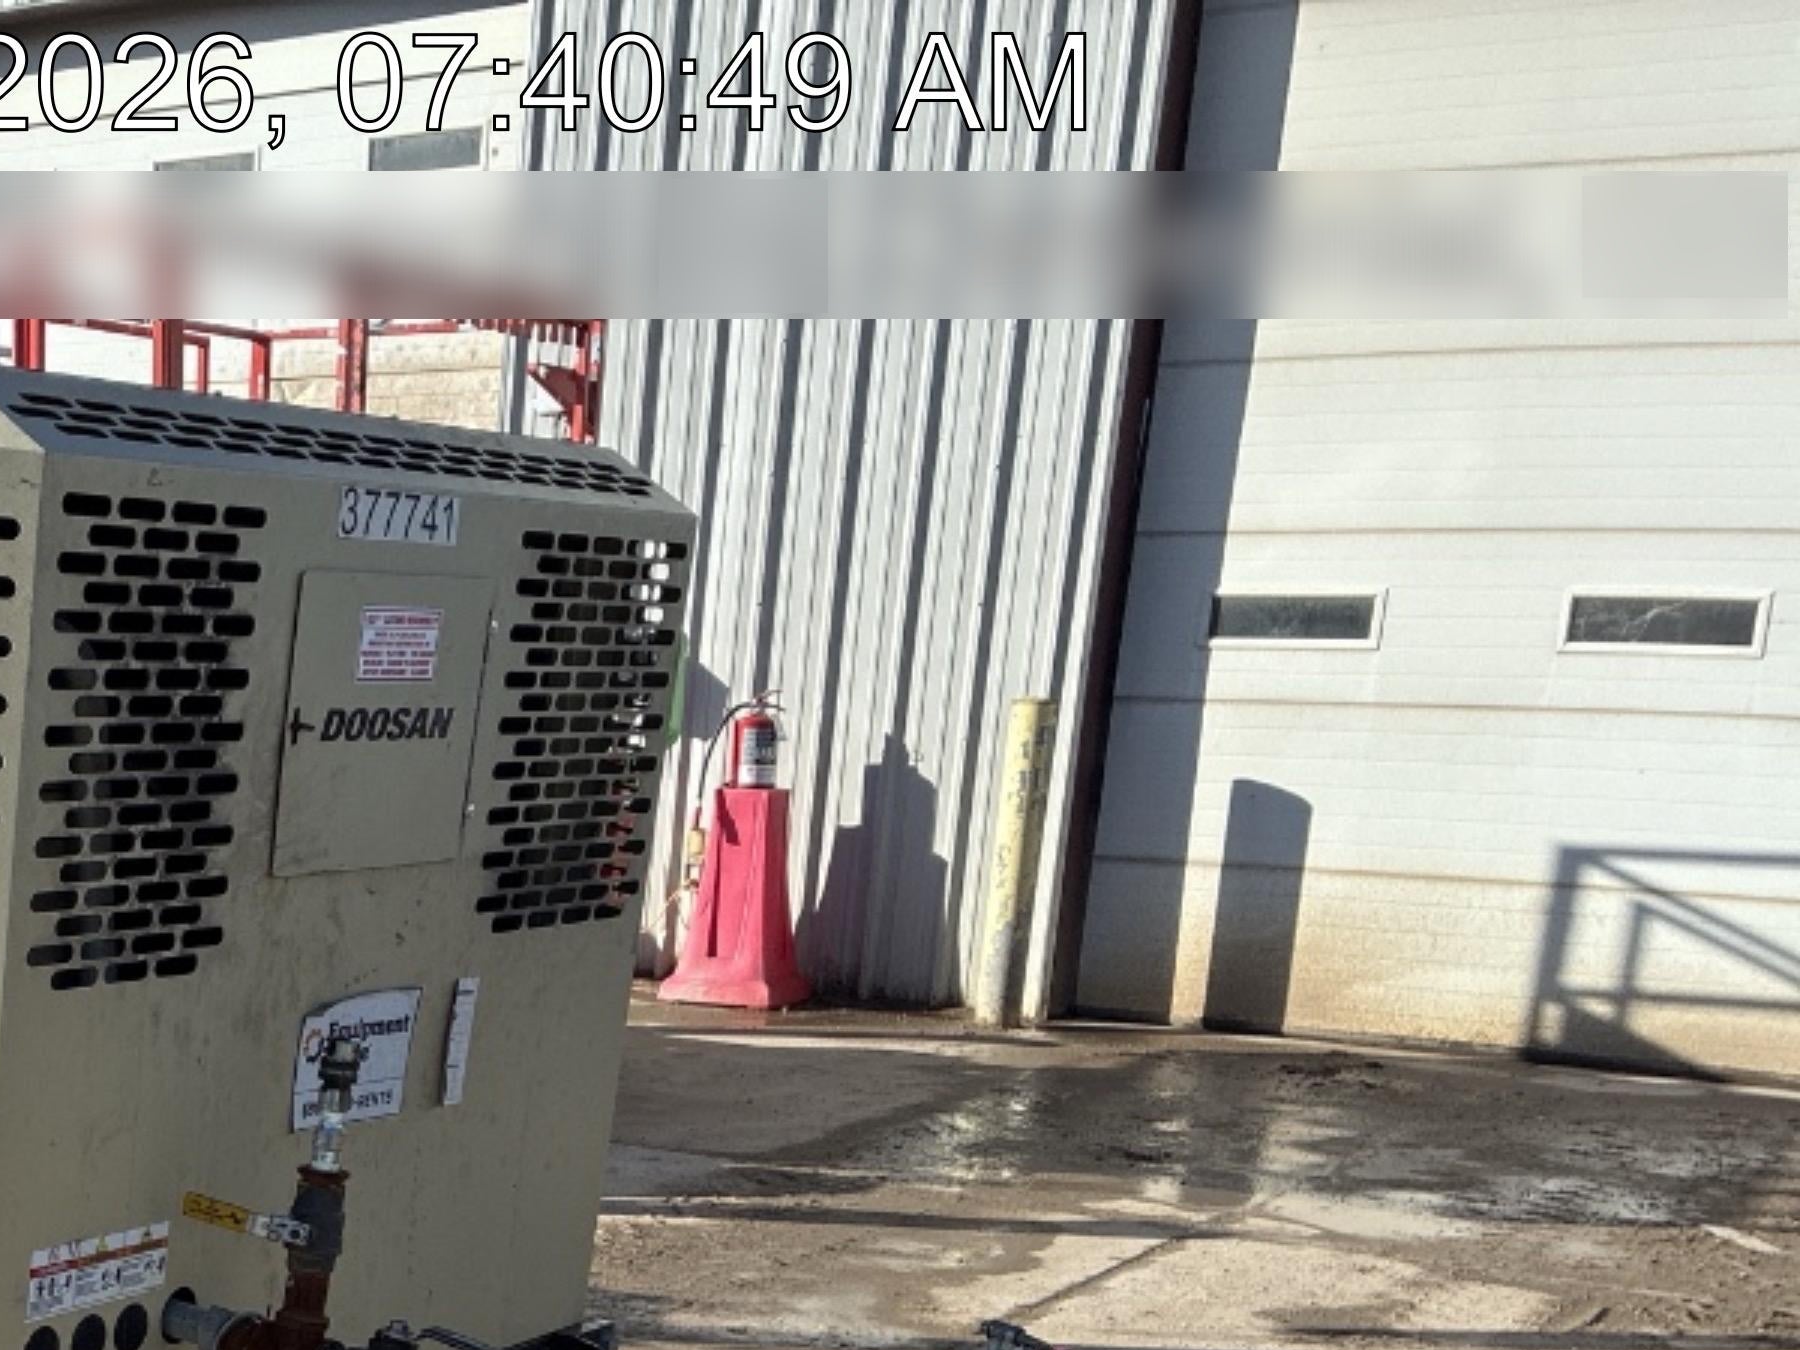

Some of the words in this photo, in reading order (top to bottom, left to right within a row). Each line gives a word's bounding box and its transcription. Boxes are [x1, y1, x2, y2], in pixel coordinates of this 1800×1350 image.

[340, 486, 455, 541] 377741
[319, 707, 455, 742] DOOSAN
[329, 1014, 410, 1041] Equipment
